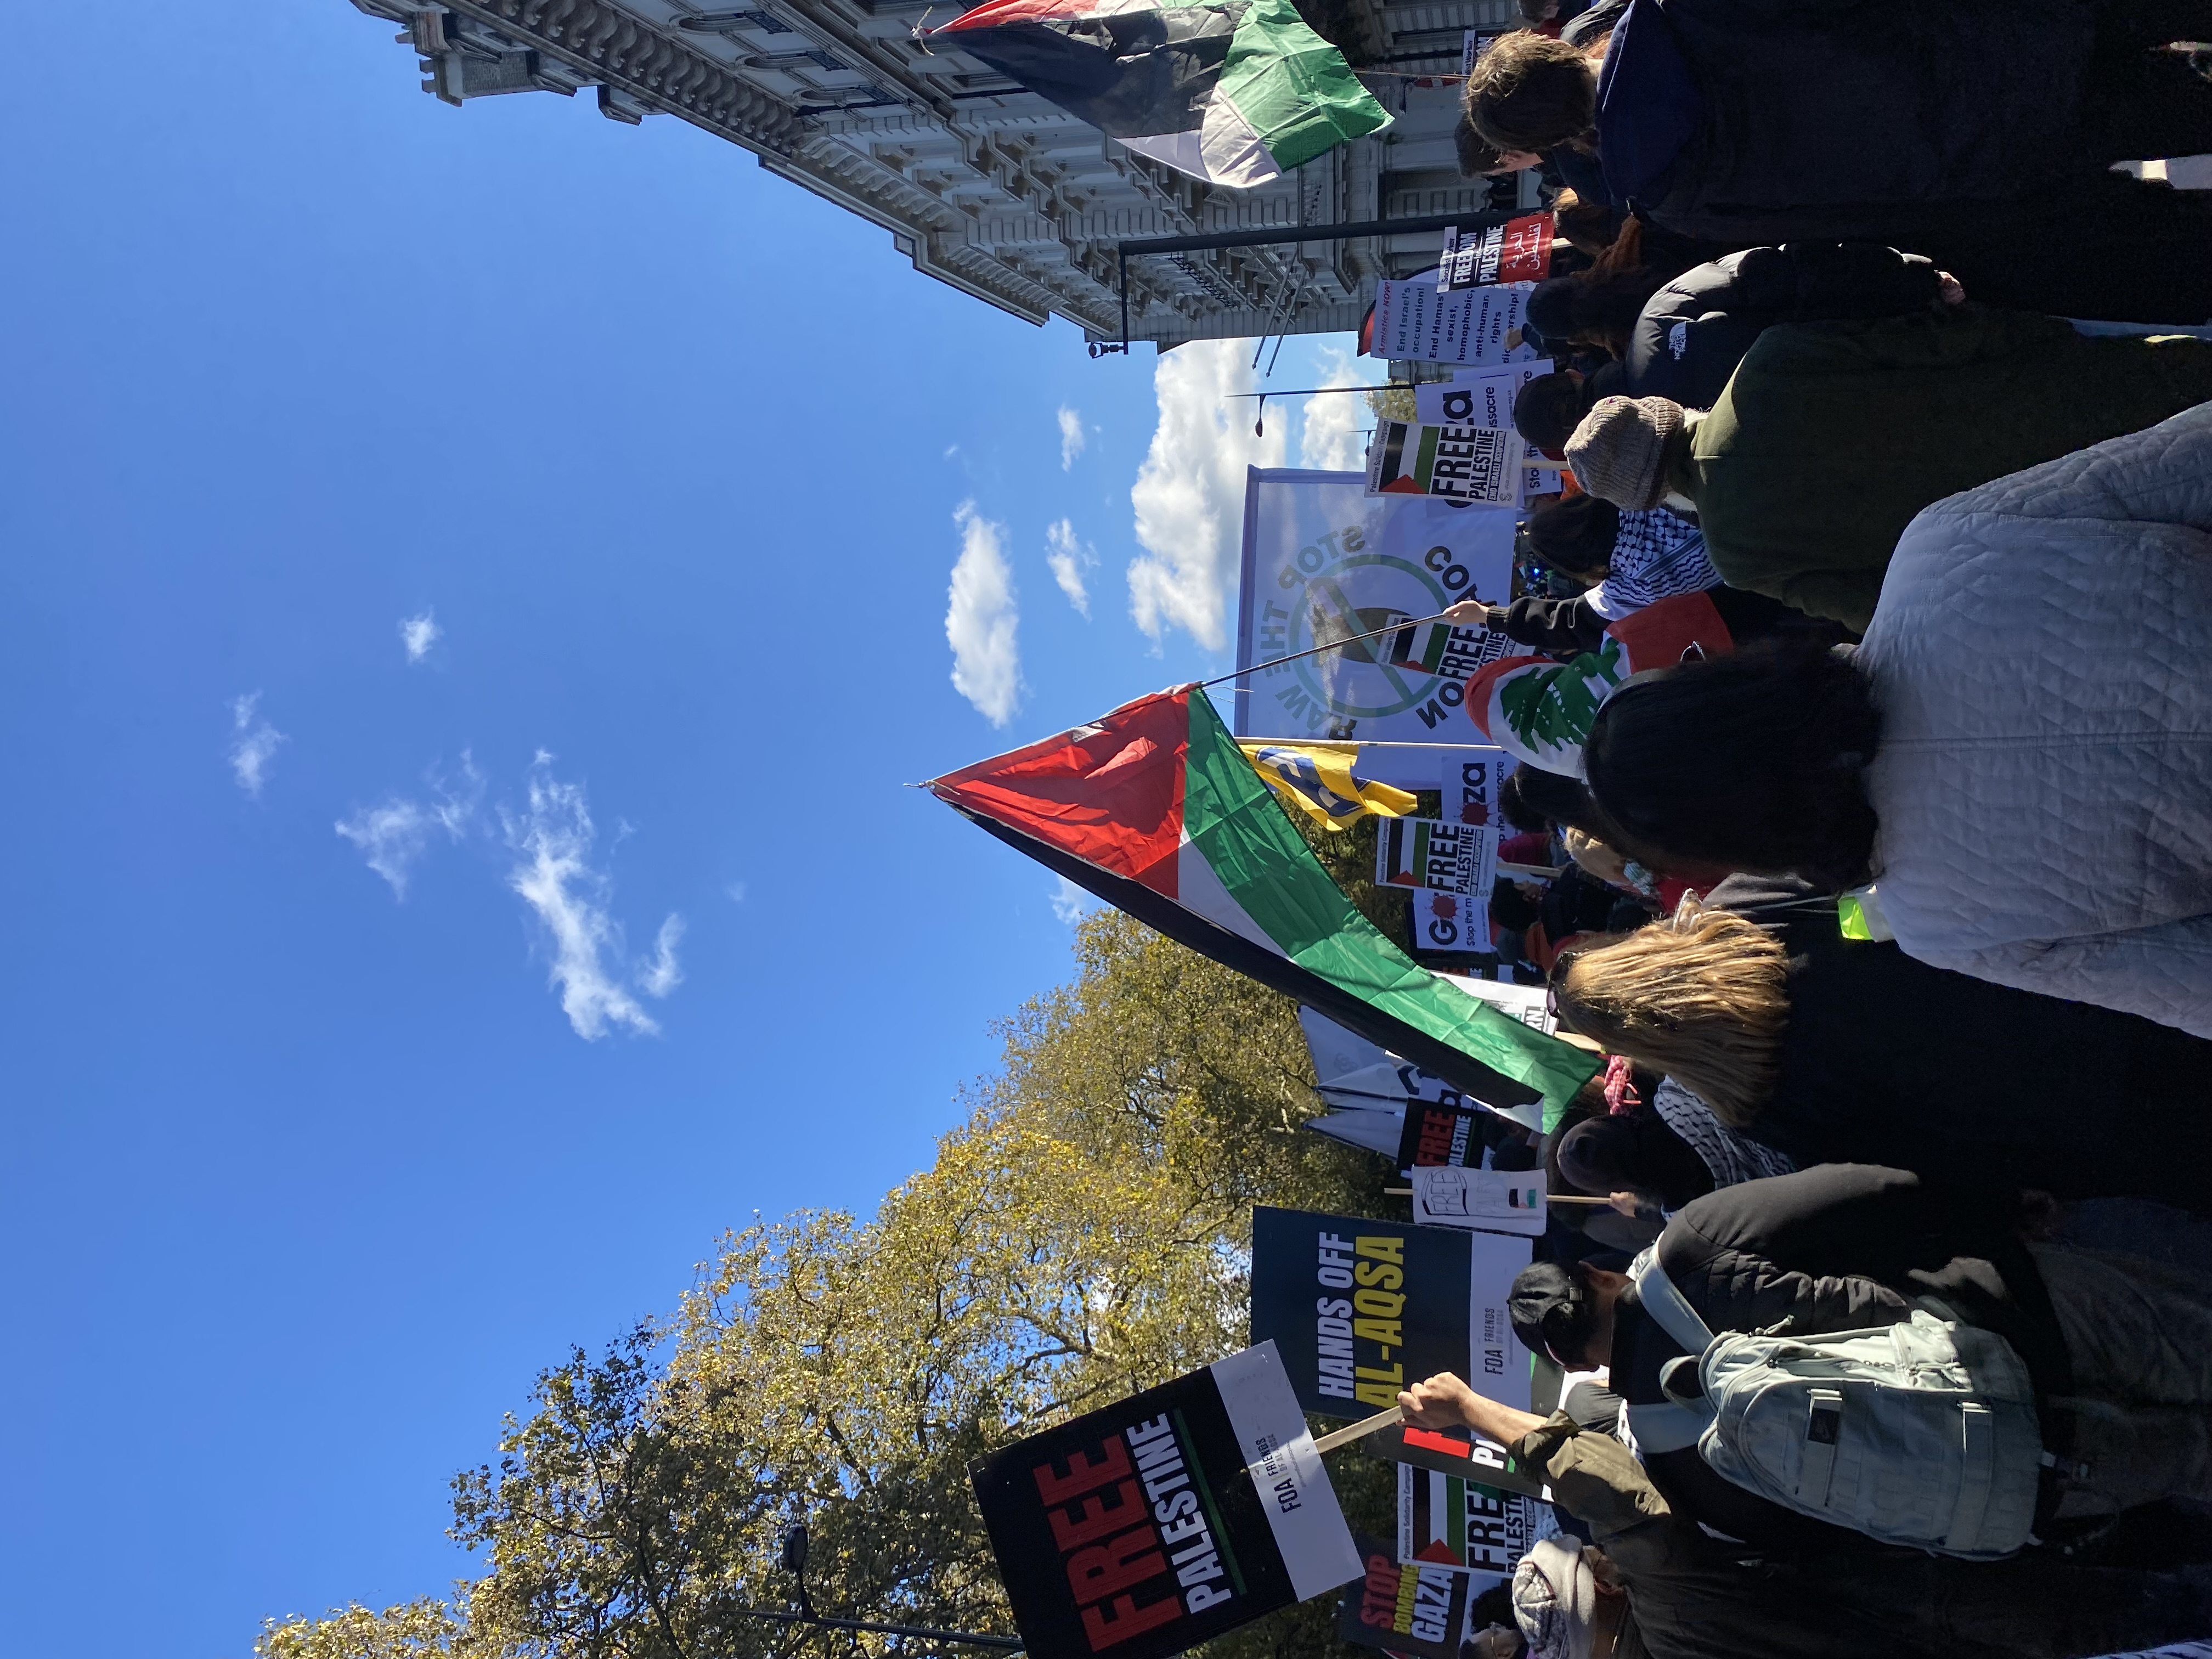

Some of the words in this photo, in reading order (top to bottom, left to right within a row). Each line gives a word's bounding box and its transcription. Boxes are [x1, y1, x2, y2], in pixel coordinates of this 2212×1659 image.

[1441, 257, 1451, 283] Socialist
[1453, 232, 1477, 284] FREEDOM
[1479, 225, 1503, 283] PALESTINE
[1505, 232, 1525, 269] الحرية
[1523, 223, 1542, 270] لفلسطين
[1383, 281, 1391, 307] NOW!
[1378, 309, 1389, 354] Armistice
[1397, 331, 1406, 352] End
[1413, 287, 1424, 353] occupation!
[1447, 306, 1459, 342] sexist,
[1457, 290, 1475, 360] homophobic,
[1475, 295, 1489, 357] anti-human
[1490, 312, 1502, 343] rights
[1429, 337, 1438, 358] End
[1431, 427, 1477, 498] FREE
[1468, 429, 1494, 500] PALESTINE
[1493, 431, 1506, 462] OCCUPATION
[1369, 466, 1380, 492] Palestine
[1488, 488, 1497, 500] END
[1490, 462, 1500, 486] ISRAELI
[1528, 467, 1541, 488] Sto
[1437, 627, 1488, 680] FREE
[1479, 633, 1506, 667] STINE
[1426, 823, 1460, 892] FREE
[1455, 827, 1474, 895] PALESTINE
[1466, 926, 1476, 946] Stop
[1415, 1110, 1455, 1166] FREE
[1449, 1115, 1472, 1166] ALESTINE
[1430, 1172, 1460, 1212] FREE
[1317, 1232, 1354, 1289] OFF
[1353, 1236, 1407, 1408] AL-AQSA
[1317, 1297, 1353, 1399] HANDS
[1485, 1350, 1503, 1375] FOA
[1255, 1437, 1278, 1476] FRIENDS
[1126, 1413, 1232, 1614] PALESTINE
[1274, 1477, 1302, 1514] FOA
[1032, 1434, 1183, 1652] FREE
[1466, 1480, 1506, 1572] FRE
[1360, 1554, 1401, 1629] STOP
[1393, 1564, 1419, 1634] BOMBING
[1411, 1567, 1453, 1643] GAZA
